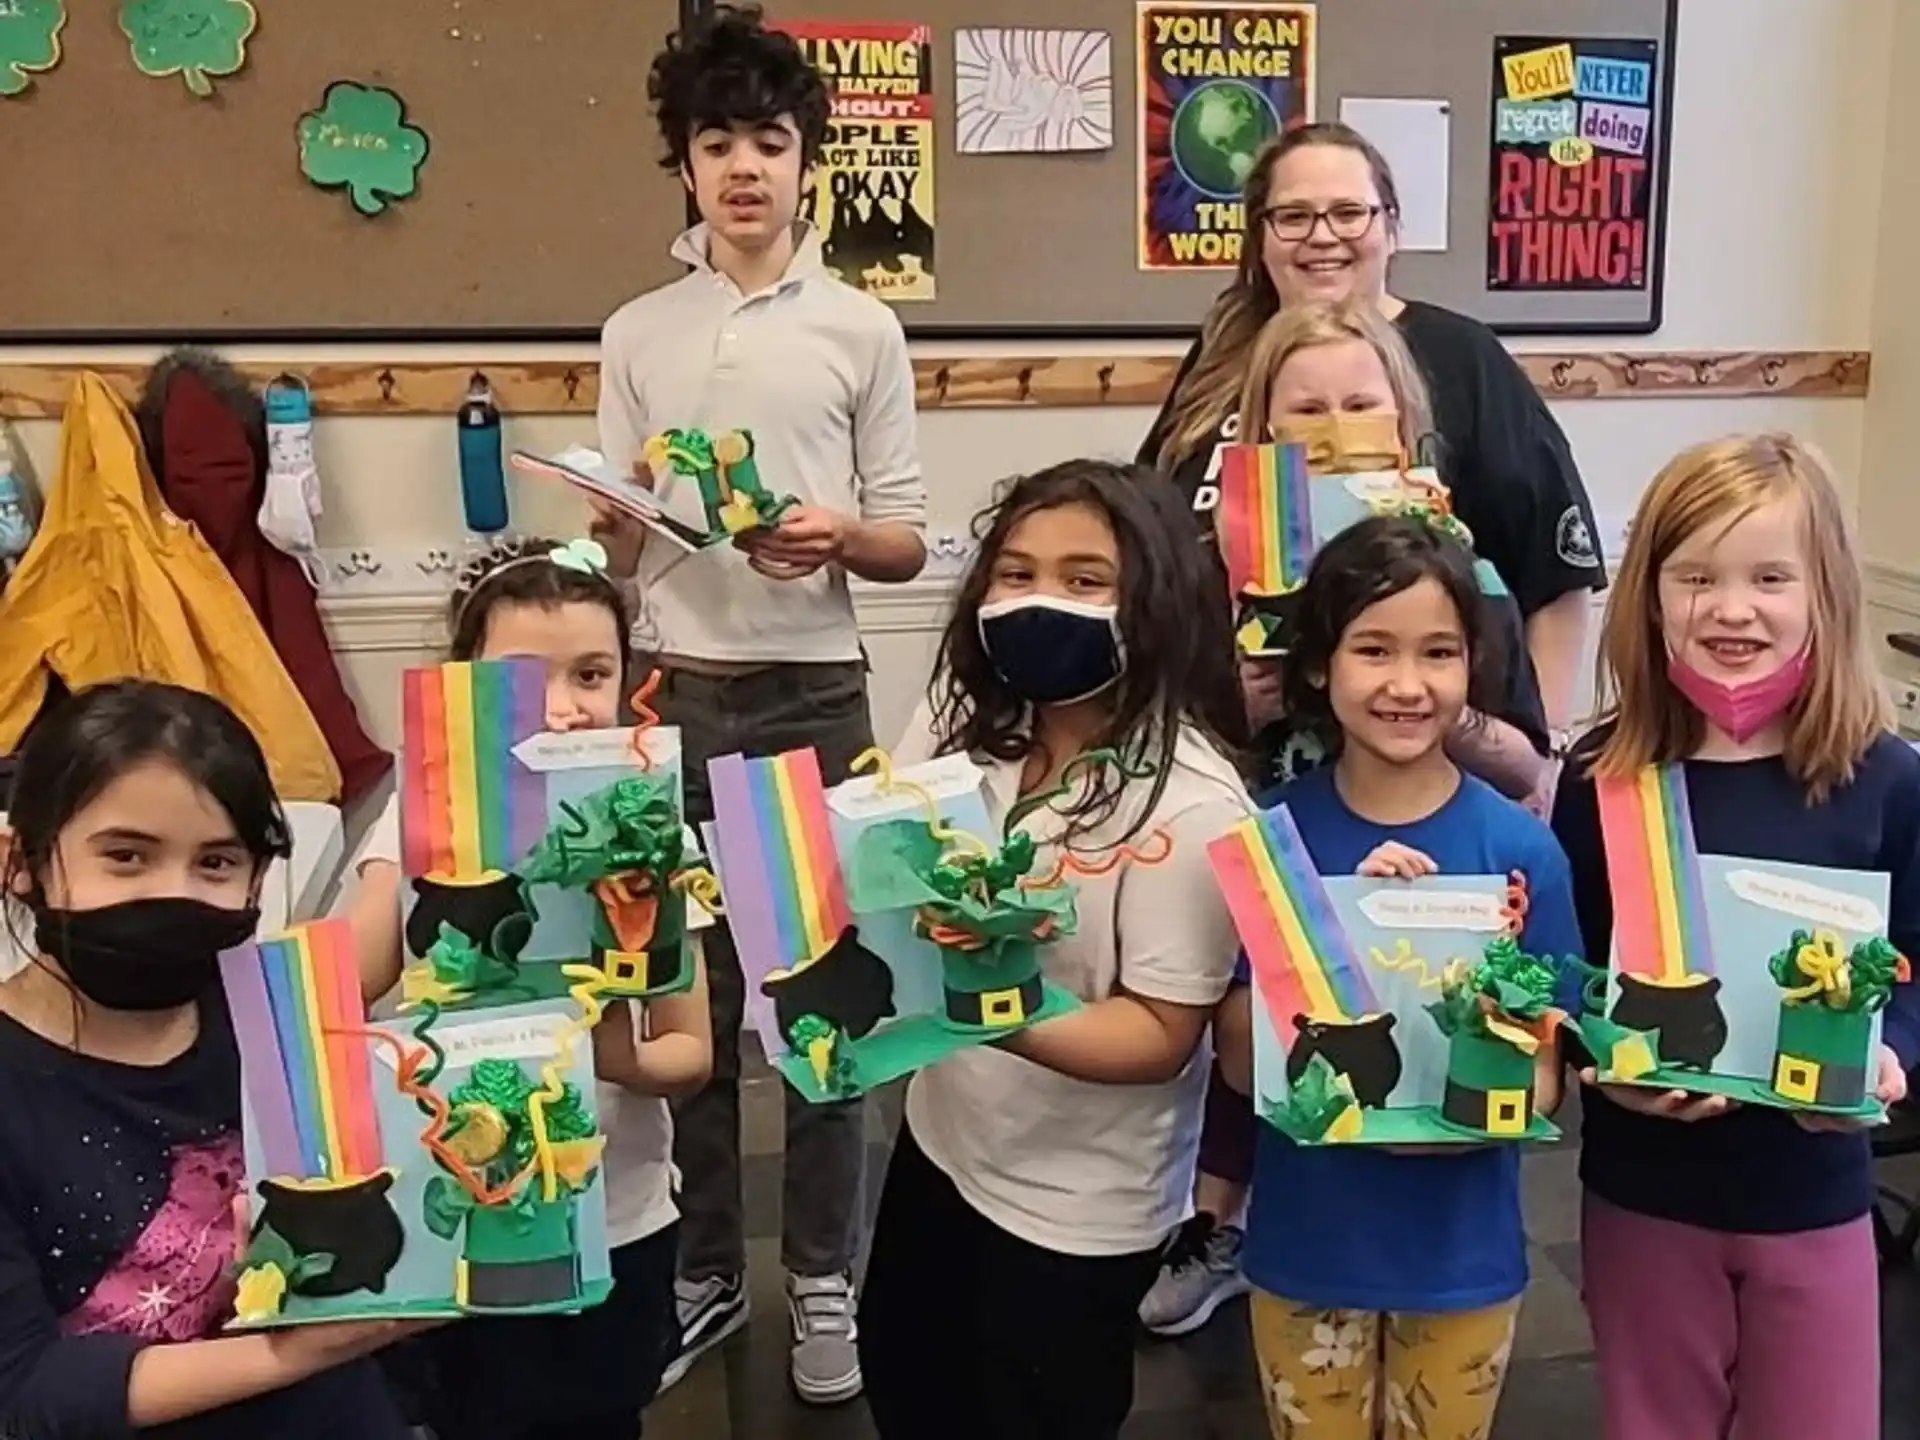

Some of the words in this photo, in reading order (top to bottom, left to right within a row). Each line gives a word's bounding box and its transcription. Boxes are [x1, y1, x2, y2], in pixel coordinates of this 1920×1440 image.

[1154, 16, 1221, 45] YOU
[1234, 18, 1300, 47] CAN
[797, 38, 918, 76] LLYING
[1161, 48, 1291, 78] CHANGE
[838, 77, 920, 94] HAPPEN
[1509, 51, 1571, 94] You'll
[1579, 63, 1645, 97] NEVER
[818, 124, 920, 146] OPLE
[1500, 105, 1575, 136] regret
[1584, 110, 1643, 149] doing
[866, 147, 921, 168] LIKE
[1558, 138, 1584, 162] the
[829, 170, 921, 202] OKAY
[1499, 152, 1646, 219] RIGHT
[1167, 232, 1244, 261] WOR
[1491, 219, 1646, 285] THING!
